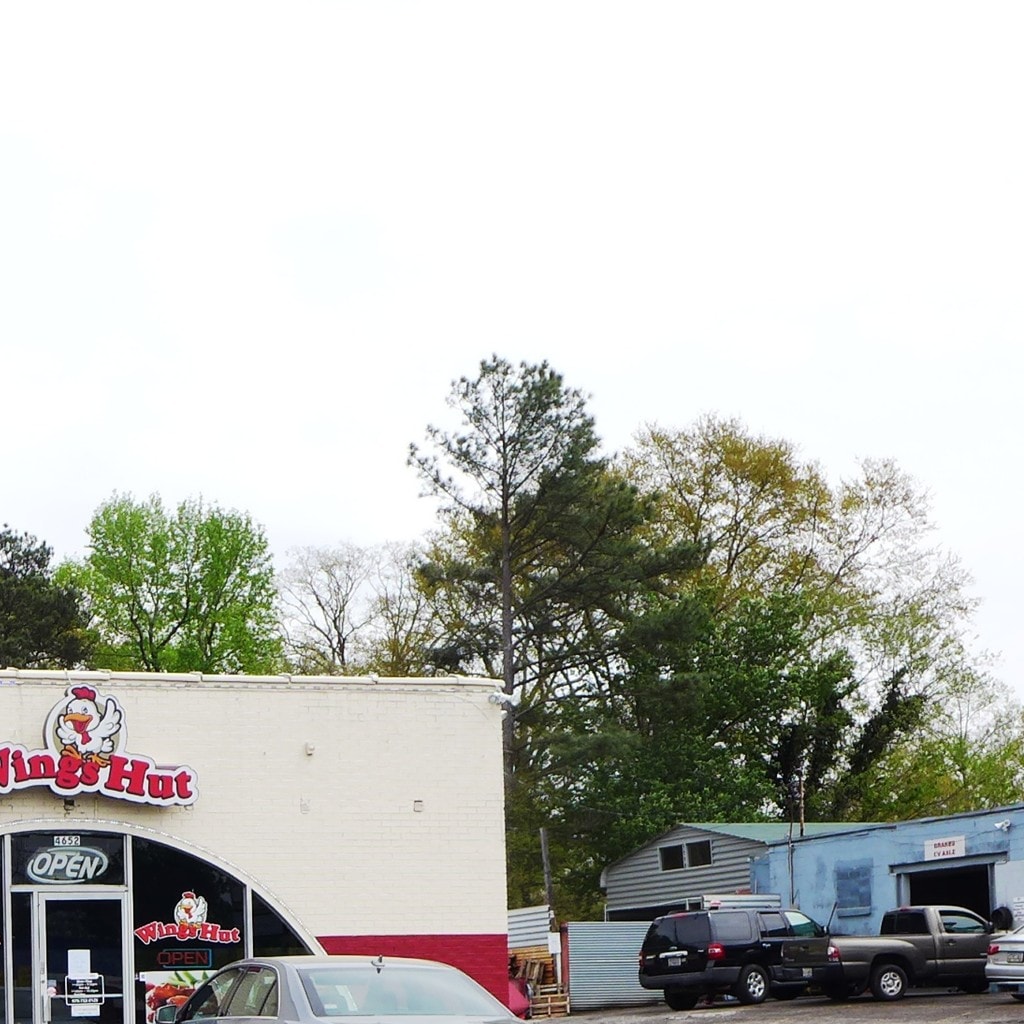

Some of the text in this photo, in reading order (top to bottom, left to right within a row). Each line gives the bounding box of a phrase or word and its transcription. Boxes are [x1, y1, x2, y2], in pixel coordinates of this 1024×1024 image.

[104, 754, 193, 800] Hut
[54, 836, 80, 846] 4652
[32, 851, 100, 879] OPEN
[134, 921, 240, 945] Wings Hut
[157, 951, 208, 965] OPEN
